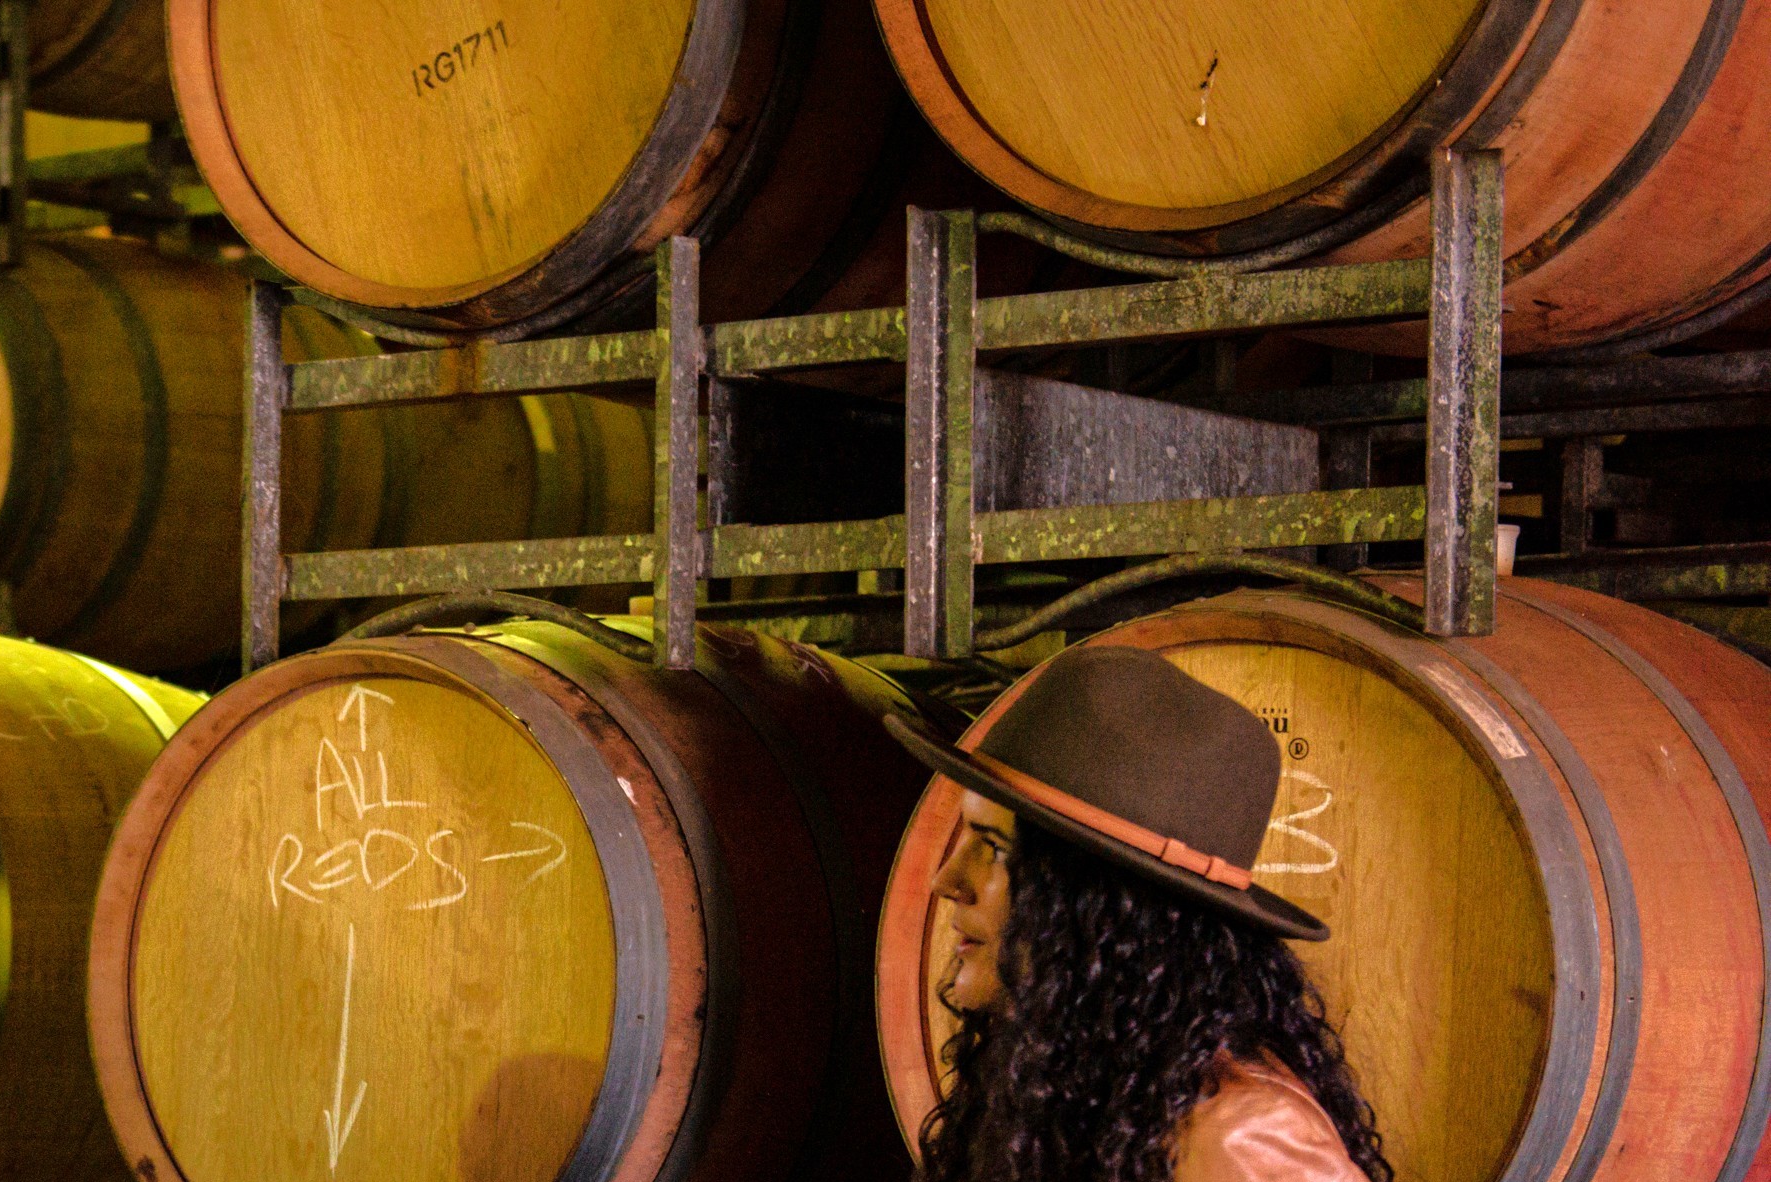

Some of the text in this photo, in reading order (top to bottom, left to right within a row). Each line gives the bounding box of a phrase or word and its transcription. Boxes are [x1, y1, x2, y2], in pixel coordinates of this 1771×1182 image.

[411, 20, 509, 97] RG1711
[316, 736, 428, 832] ALL
[267, 829, 468, 909] REDS
